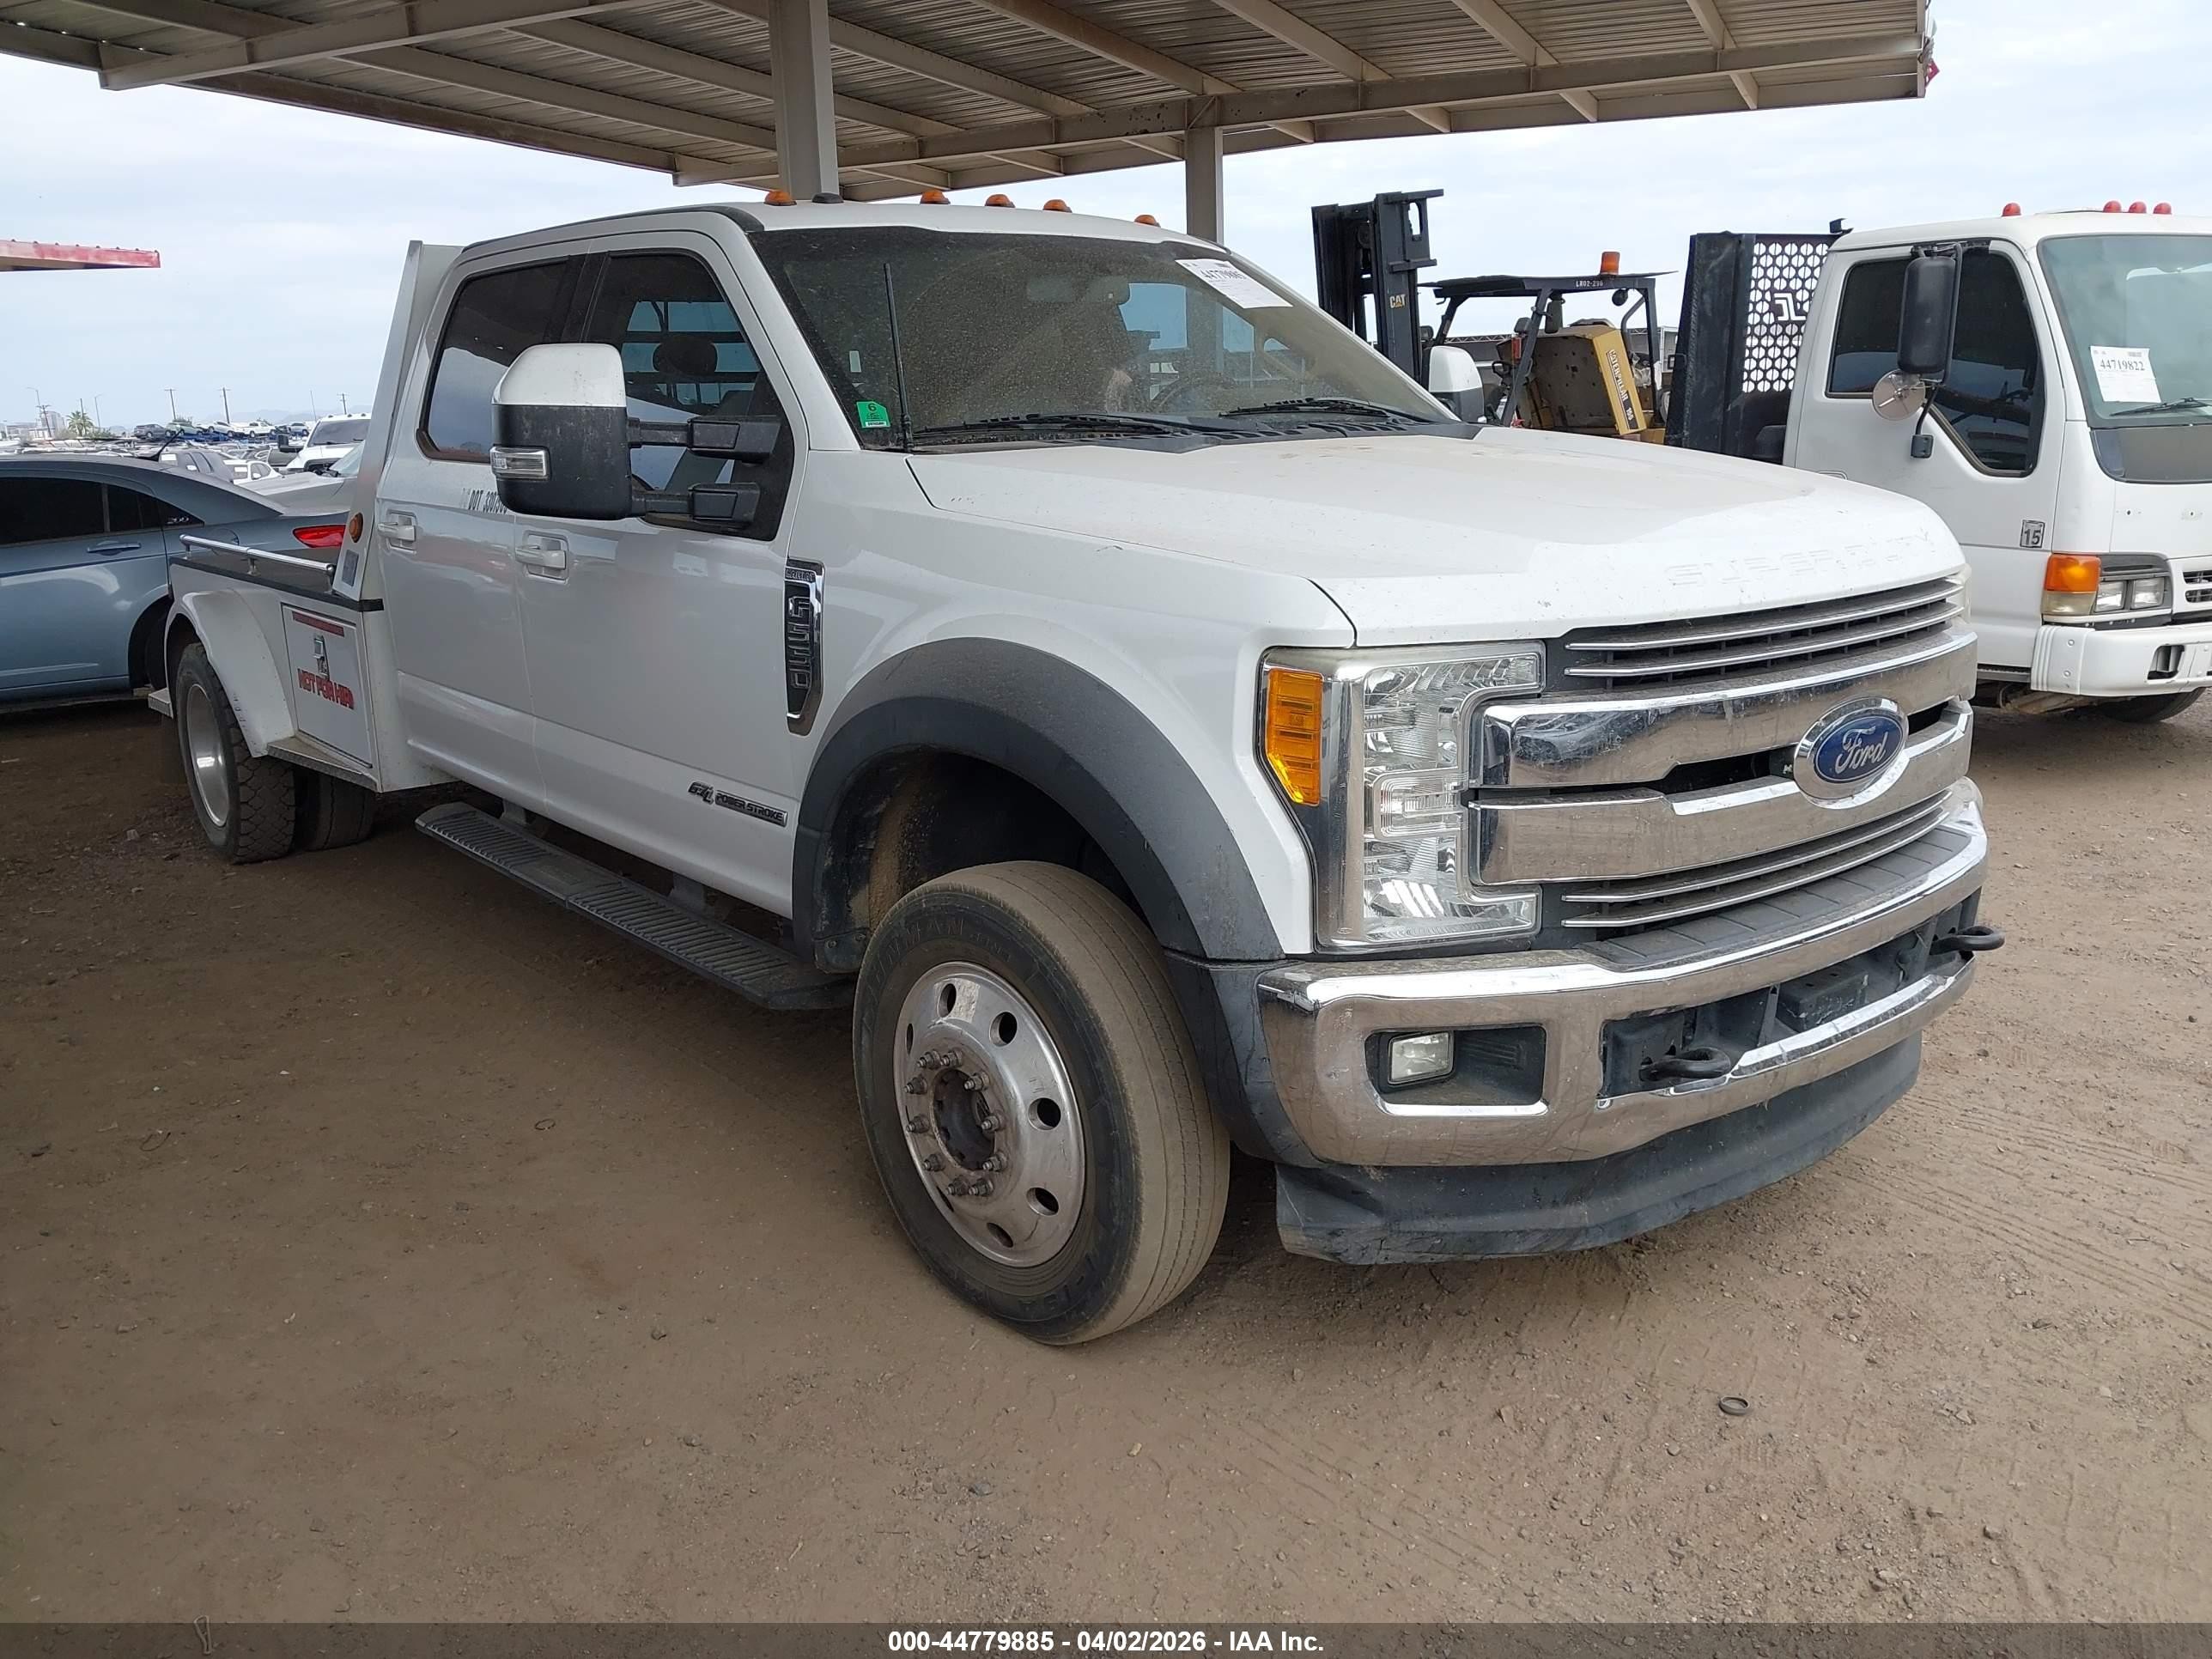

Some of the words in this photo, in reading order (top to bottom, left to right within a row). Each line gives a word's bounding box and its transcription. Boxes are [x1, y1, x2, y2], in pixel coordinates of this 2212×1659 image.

[1389, 294, 1406, 309] CAT
[2100, 359, 2146, 372] 44719822
[1608, 349, 1629, 402] CATERPILLAR
[867, 403, 877, 412] 6
[468, 489, 483, 511] DOT
[2024, 528, 2041, 545] 15
[785, 568, 814, 582] LARIAT
[1834, 726, 1889, 774] Ford
[715, 792, 746, 810] POWER
[746, 802, 783, 821] STROKE
